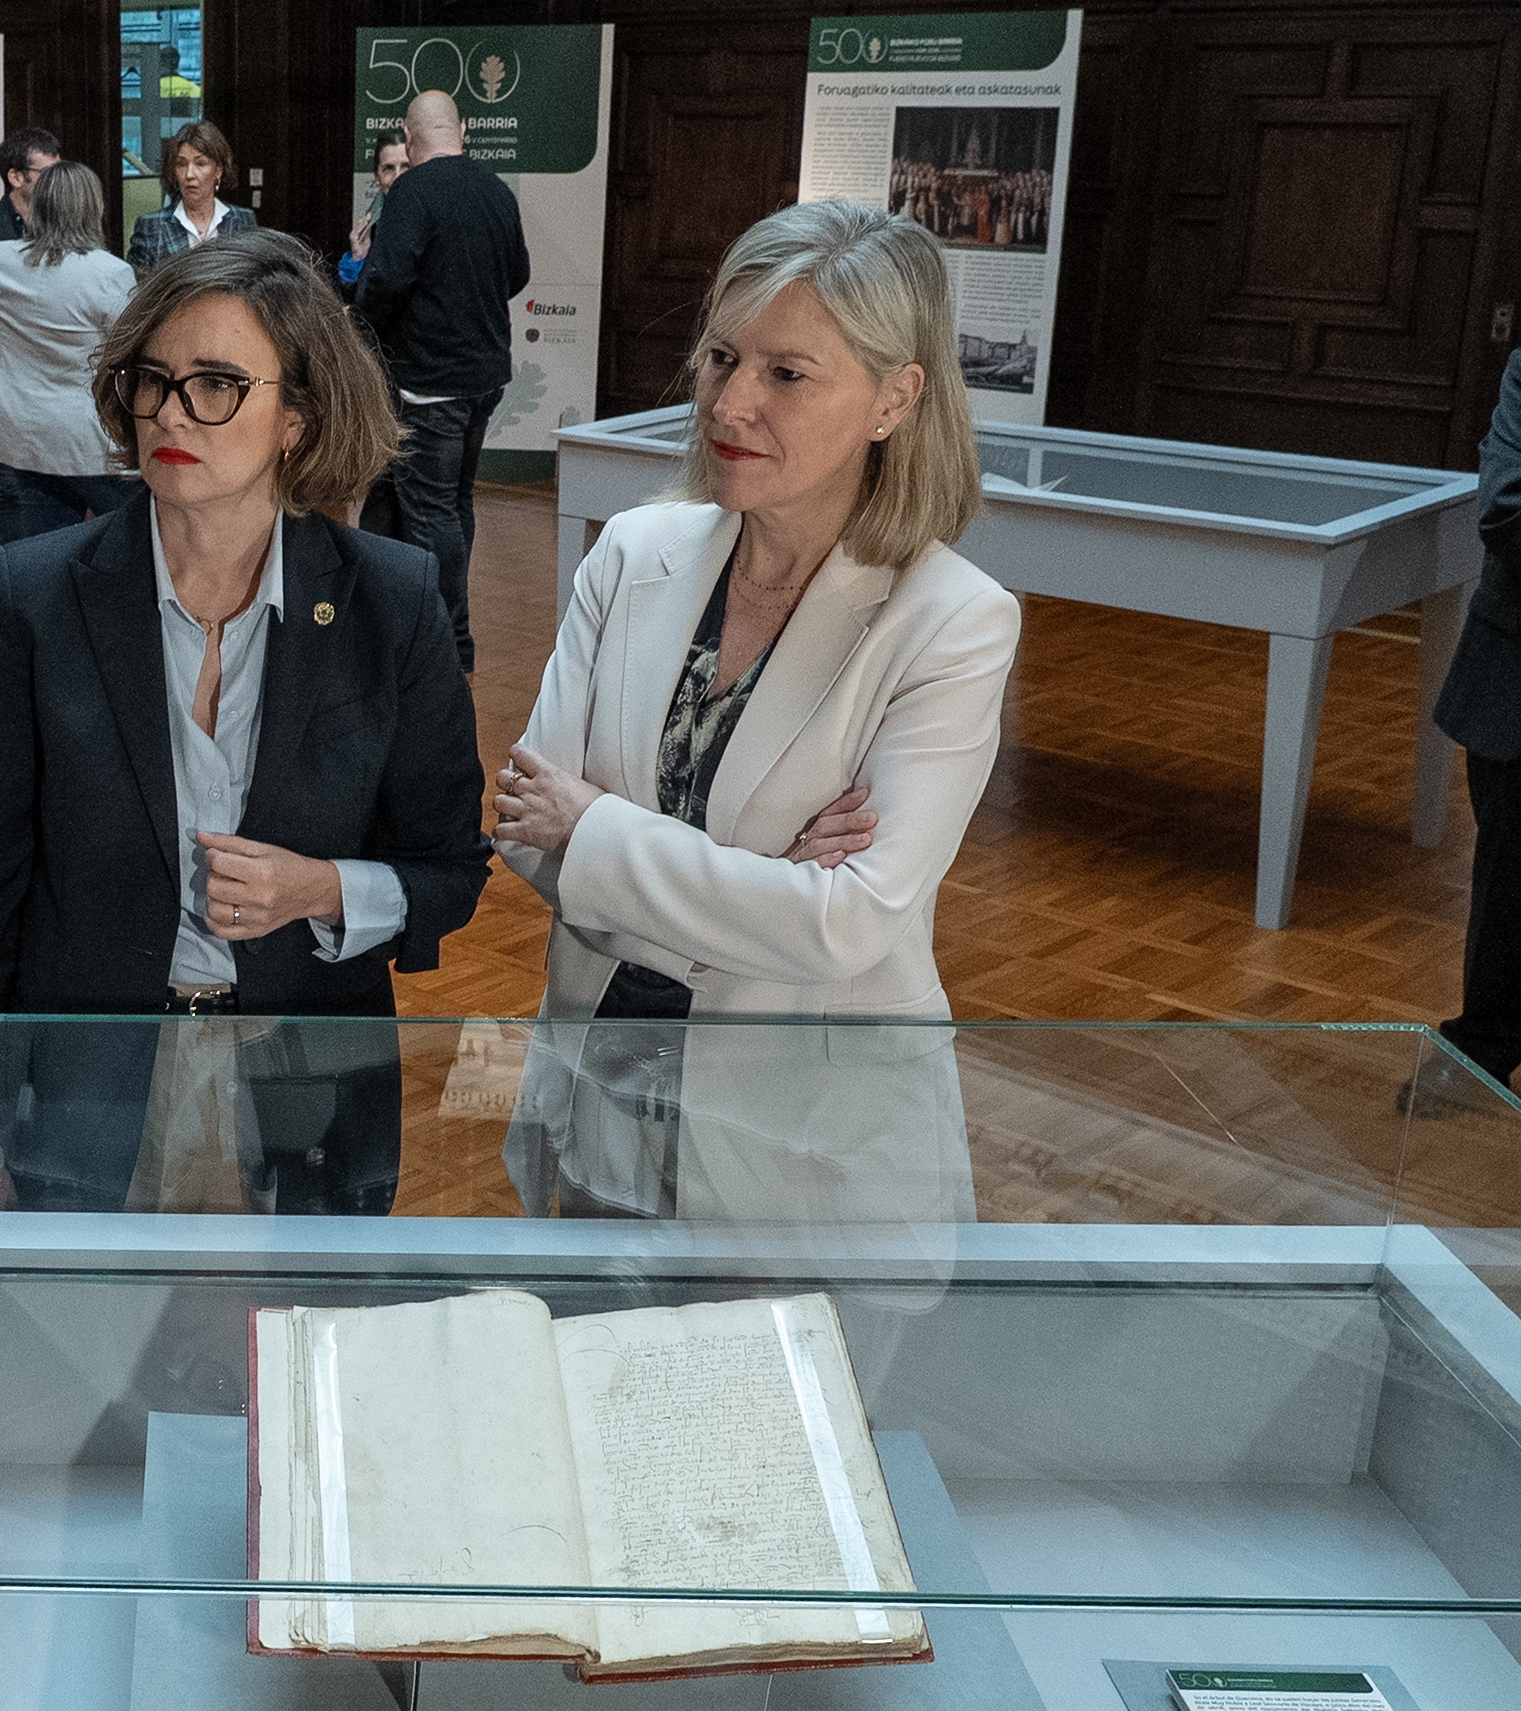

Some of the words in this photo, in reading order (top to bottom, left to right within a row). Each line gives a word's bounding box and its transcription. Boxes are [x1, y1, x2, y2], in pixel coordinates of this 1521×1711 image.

[817, 84, 889, 98] Foruagatiko
[890, 84, 952, 97] kalitateak
[954, 85, 975, 97] eta
[977, 83, 1063, 97] askatasunak
[365, 117, 405, 130] BIZKA
[467, 117, 518, 130] BARRIA
[469, 148, 517, 160] BIZKAIA
[533, 303, 577, 316] Bizkaia
